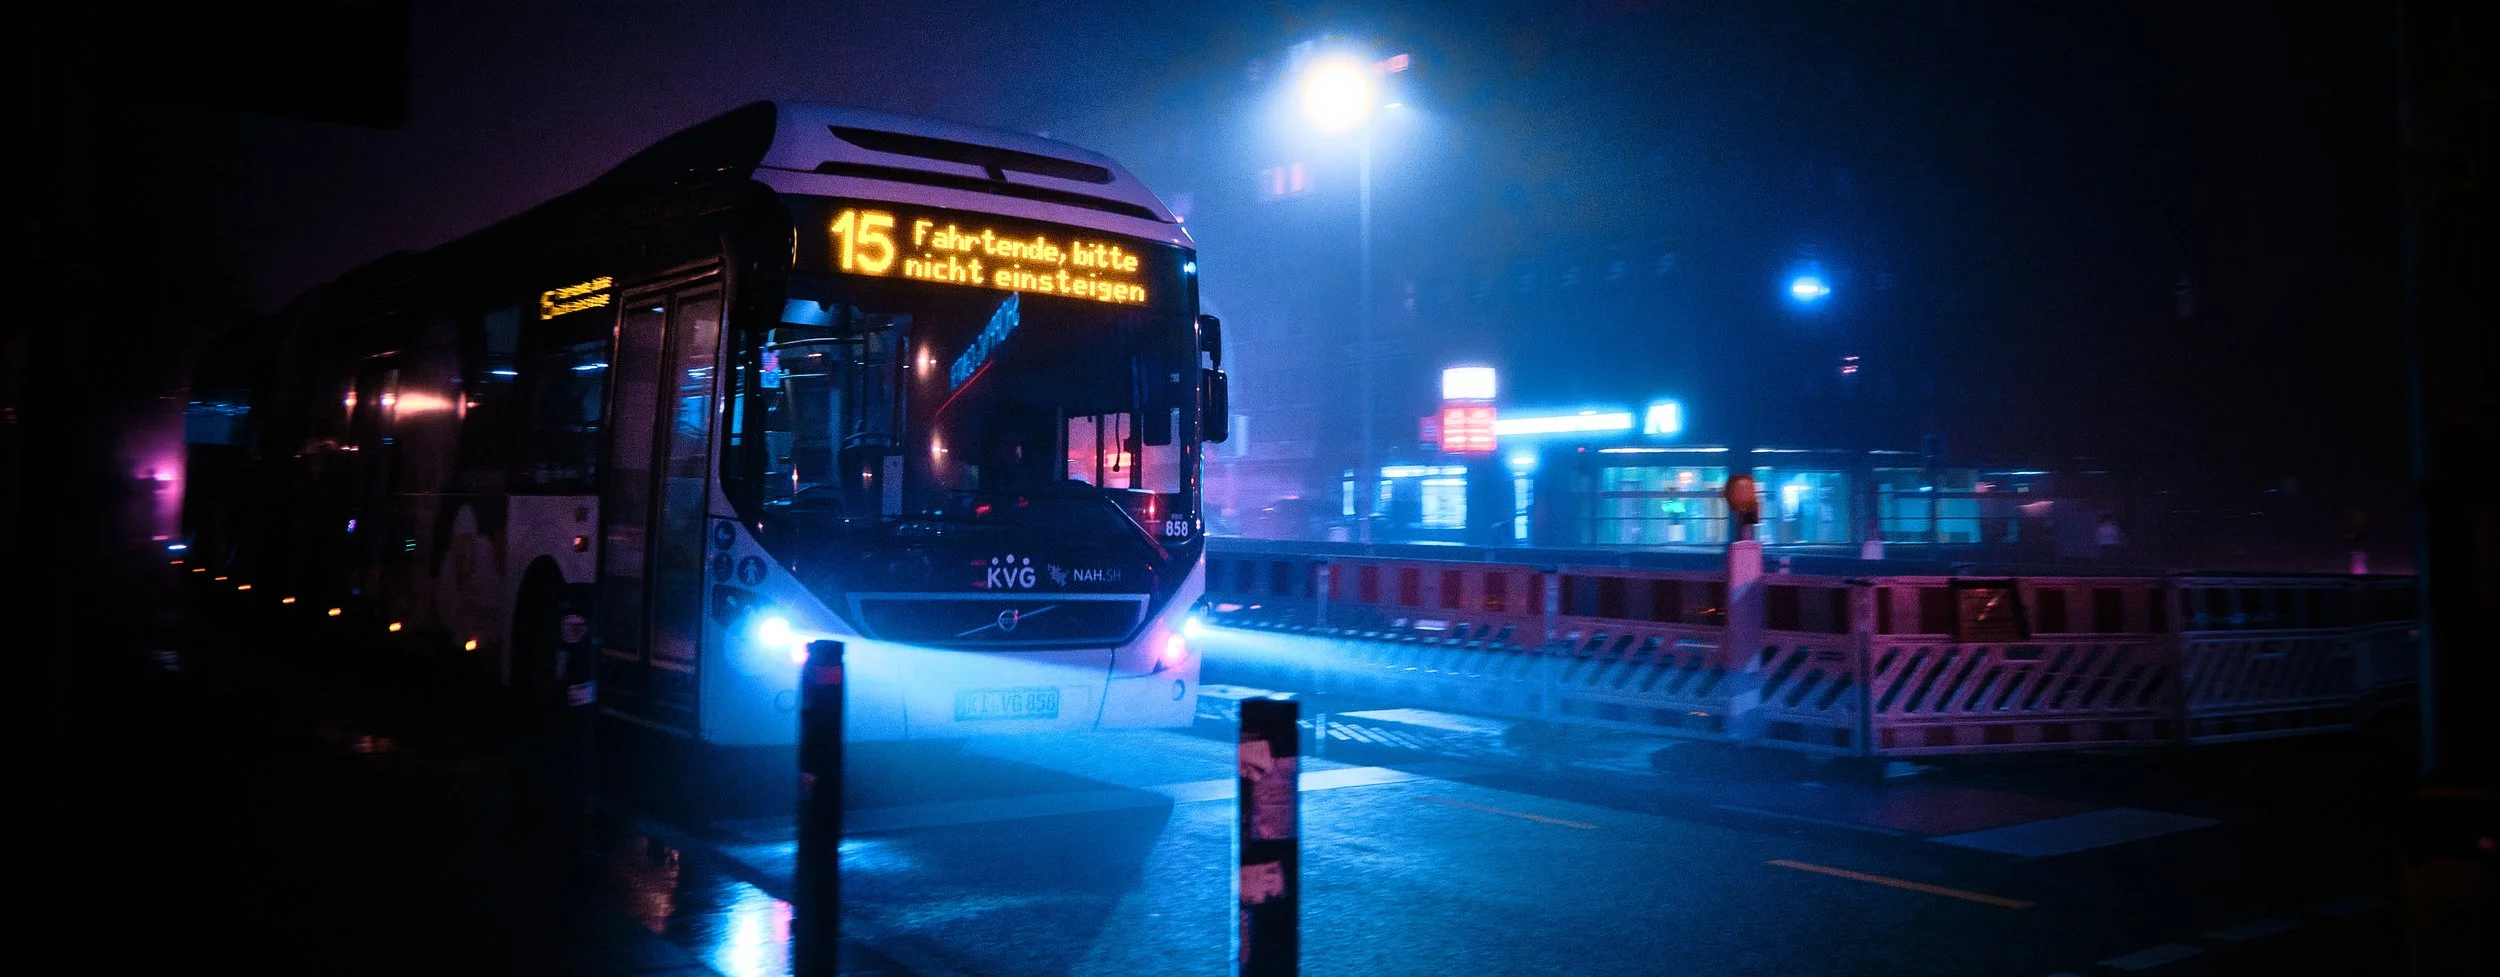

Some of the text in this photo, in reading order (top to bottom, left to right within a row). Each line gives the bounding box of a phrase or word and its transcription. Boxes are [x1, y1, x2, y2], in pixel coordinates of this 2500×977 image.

[831, 211, 895, 273] 15
[915, 219, 1138, 272] Fahrtende, bitte
[905, 253, 1145, 303] nicht einsteigen
[1166, 520, 1188, 537] 858
[987, 566, 1037, 589] KVG
[1073, 568, 1121, 582] NAH.SH
